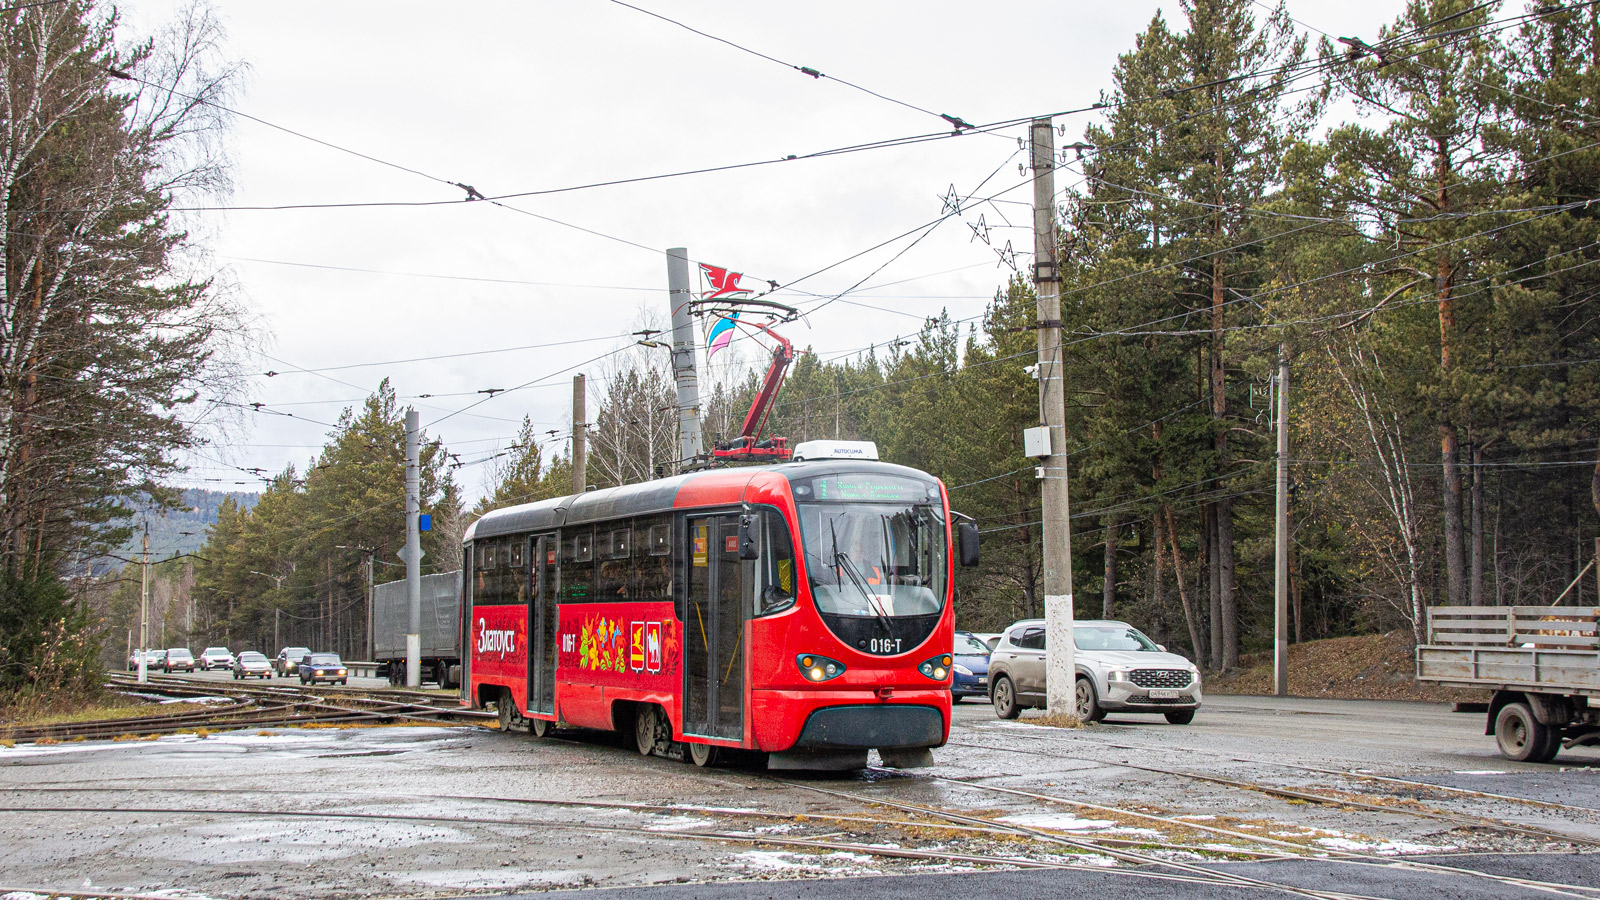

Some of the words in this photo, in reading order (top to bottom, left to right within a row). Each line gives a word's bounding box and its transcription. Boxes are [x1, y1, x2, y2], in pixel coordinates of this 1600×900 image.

[478, 617, 515, 660] Златоуст
[562, 633, 576, 653] 016-Т
[870, 638, 902, 653] 016-Т
